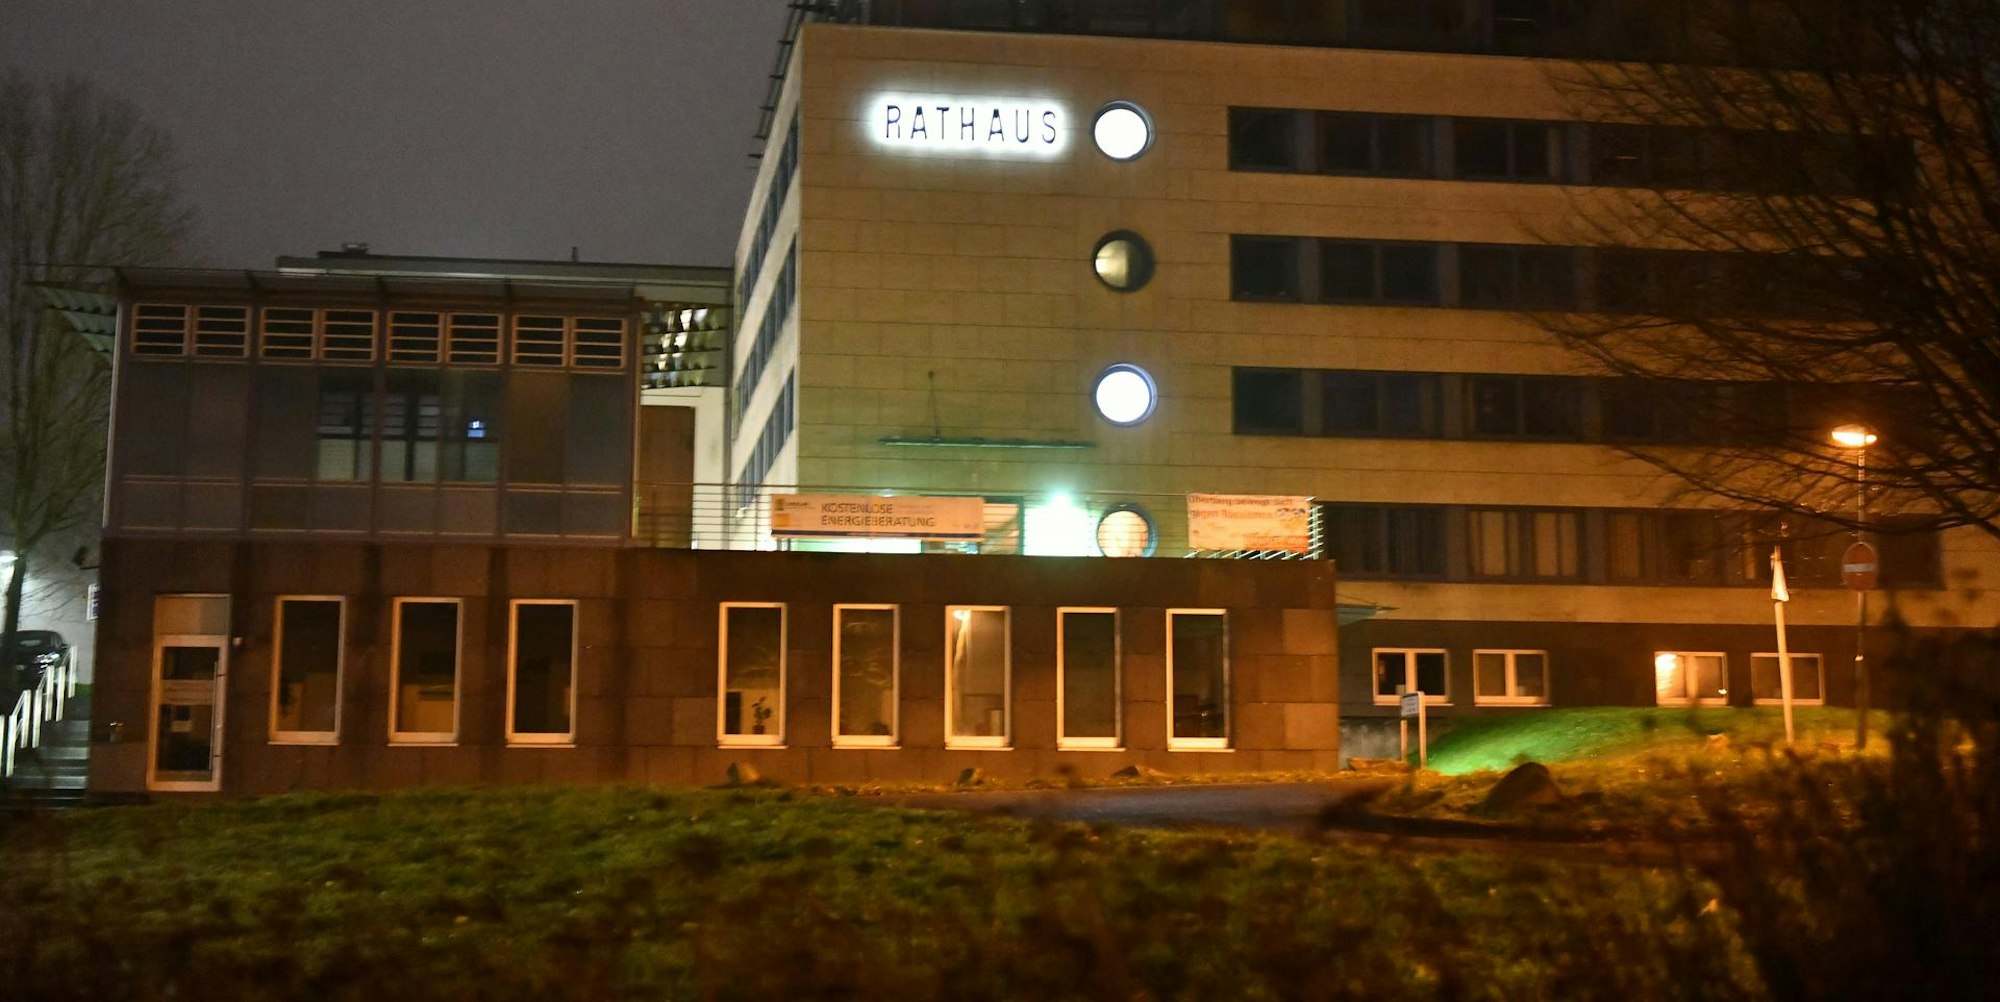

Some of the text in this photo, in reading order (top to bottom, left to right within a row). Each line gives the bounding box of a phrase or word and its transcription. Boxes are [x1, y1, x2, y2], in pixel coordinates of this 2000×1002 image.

[885, 104, 1057, 144] RATHAUS
[821, 502, 893, 514] KOSTENLOSE
[821, 515, 935, 527] ENERGIEBERATUNG
